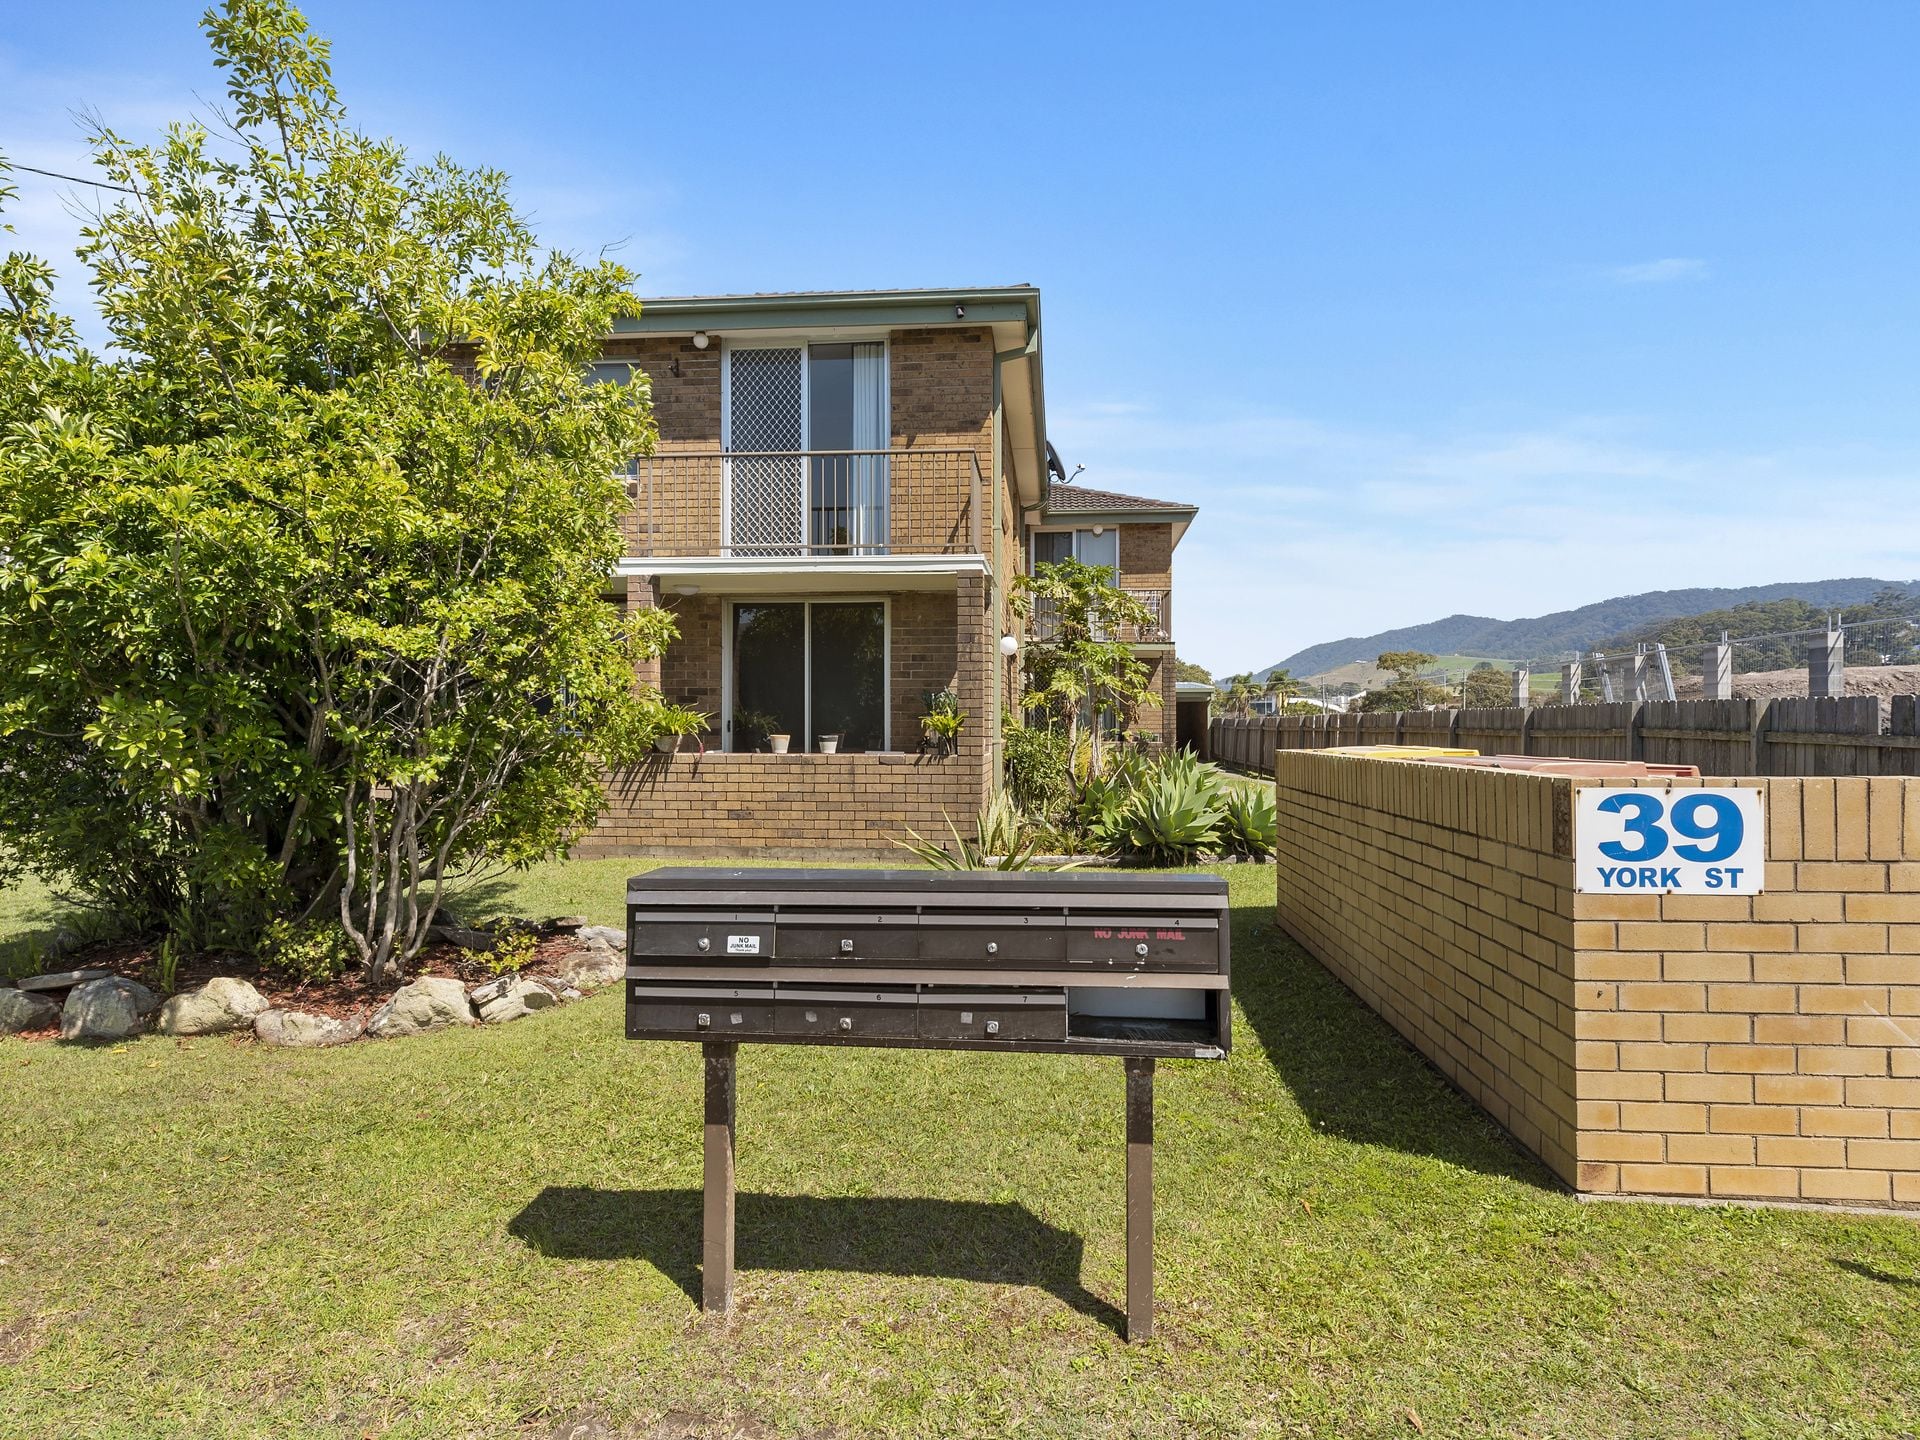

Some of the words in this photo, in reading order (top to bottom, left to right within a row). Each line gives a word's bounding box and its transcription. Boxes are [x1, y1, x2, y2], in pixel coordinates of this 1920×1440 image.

[1597, 793, 1744, 863] 39
[1597, 867, 1682, 888] YORK
[1705, 867, 1744, 889] ST
[1094, 928, 1112, 939] NO
[1117, 928, 1149, 939] JUNK
[1156, 928, 1186, 941] MAIL
